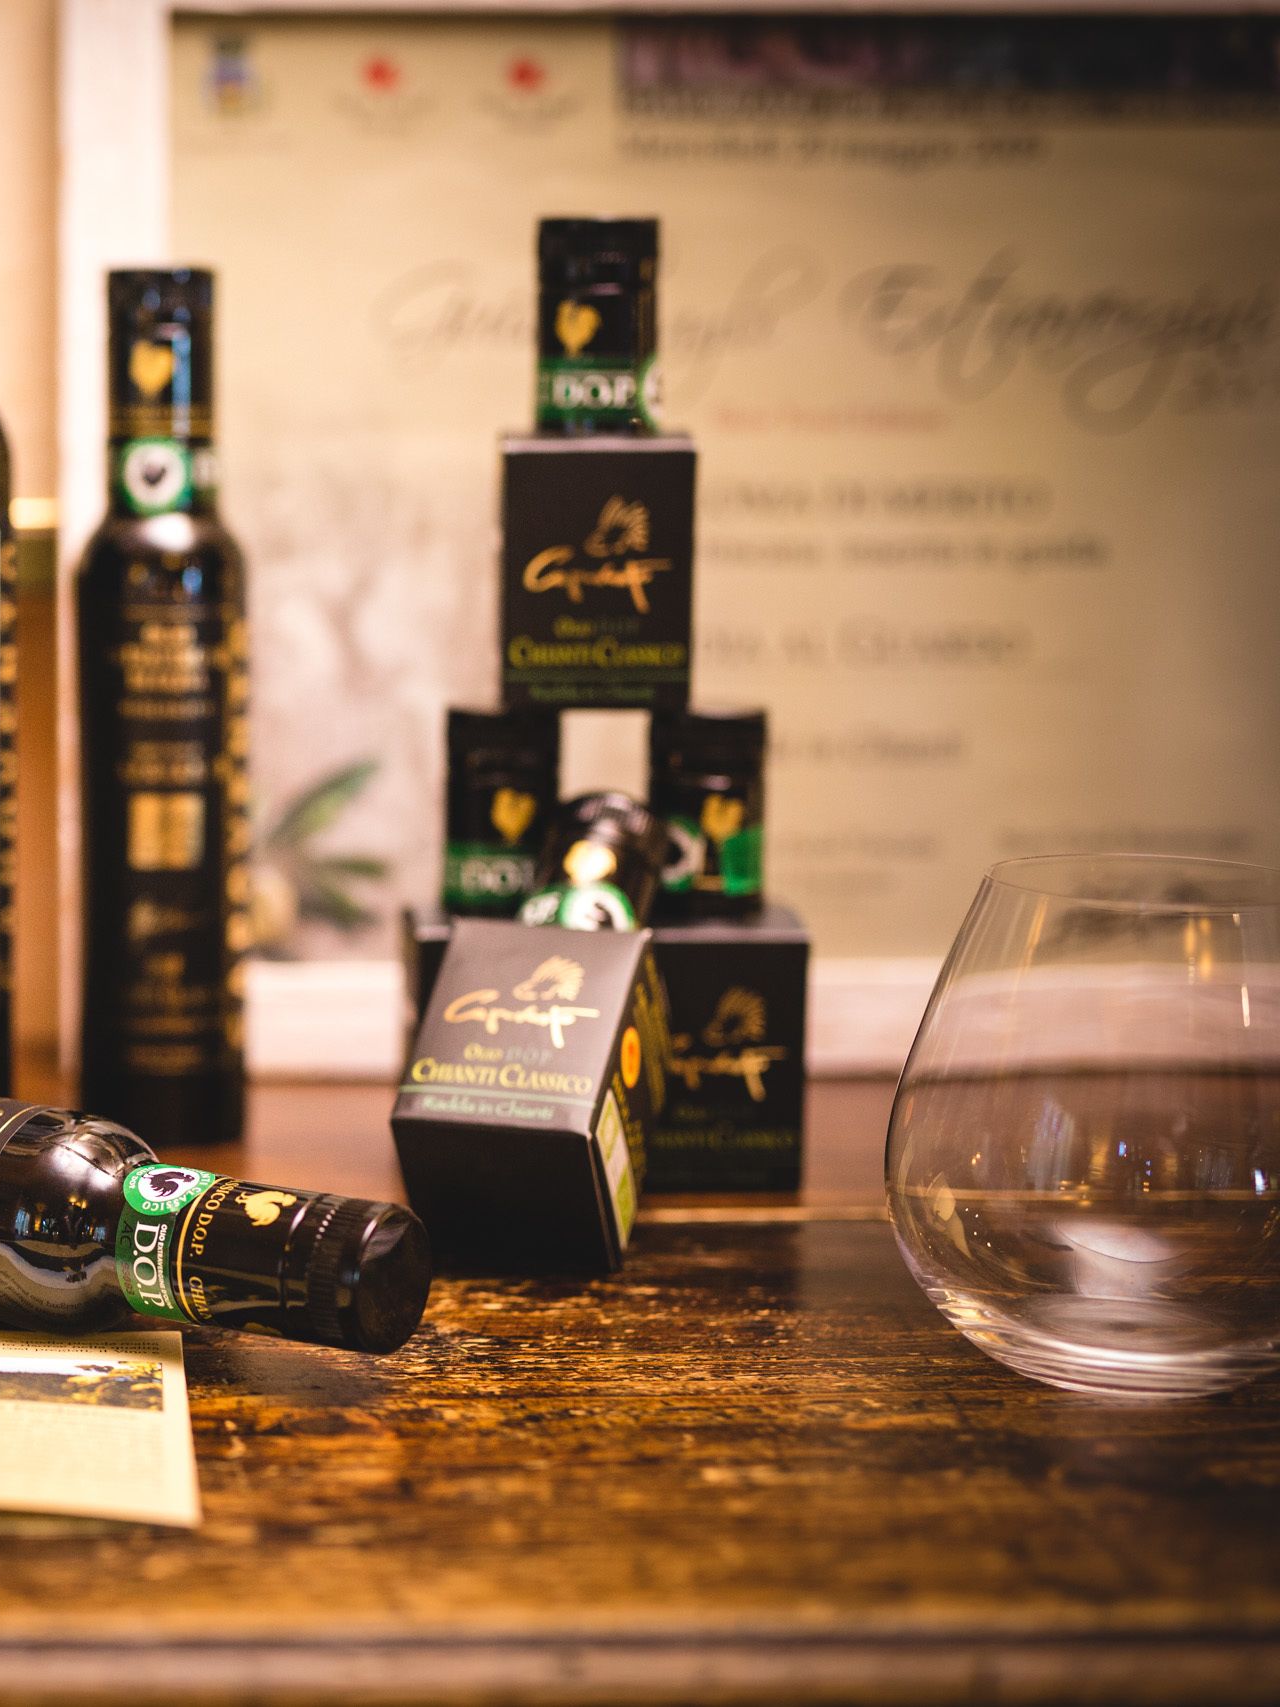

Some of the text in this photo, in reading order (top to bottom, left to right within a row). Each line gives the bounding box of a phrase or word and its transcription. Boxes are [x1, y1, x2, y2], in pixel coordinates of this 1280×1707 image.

[141, 1187, 202, 1212] CLASSICO
[159, 1223, 168, 1241] OLIO
[189, 1213, 214, 1257] D.O.P.
[132, 1220, 165, 1307] D.O.P.
